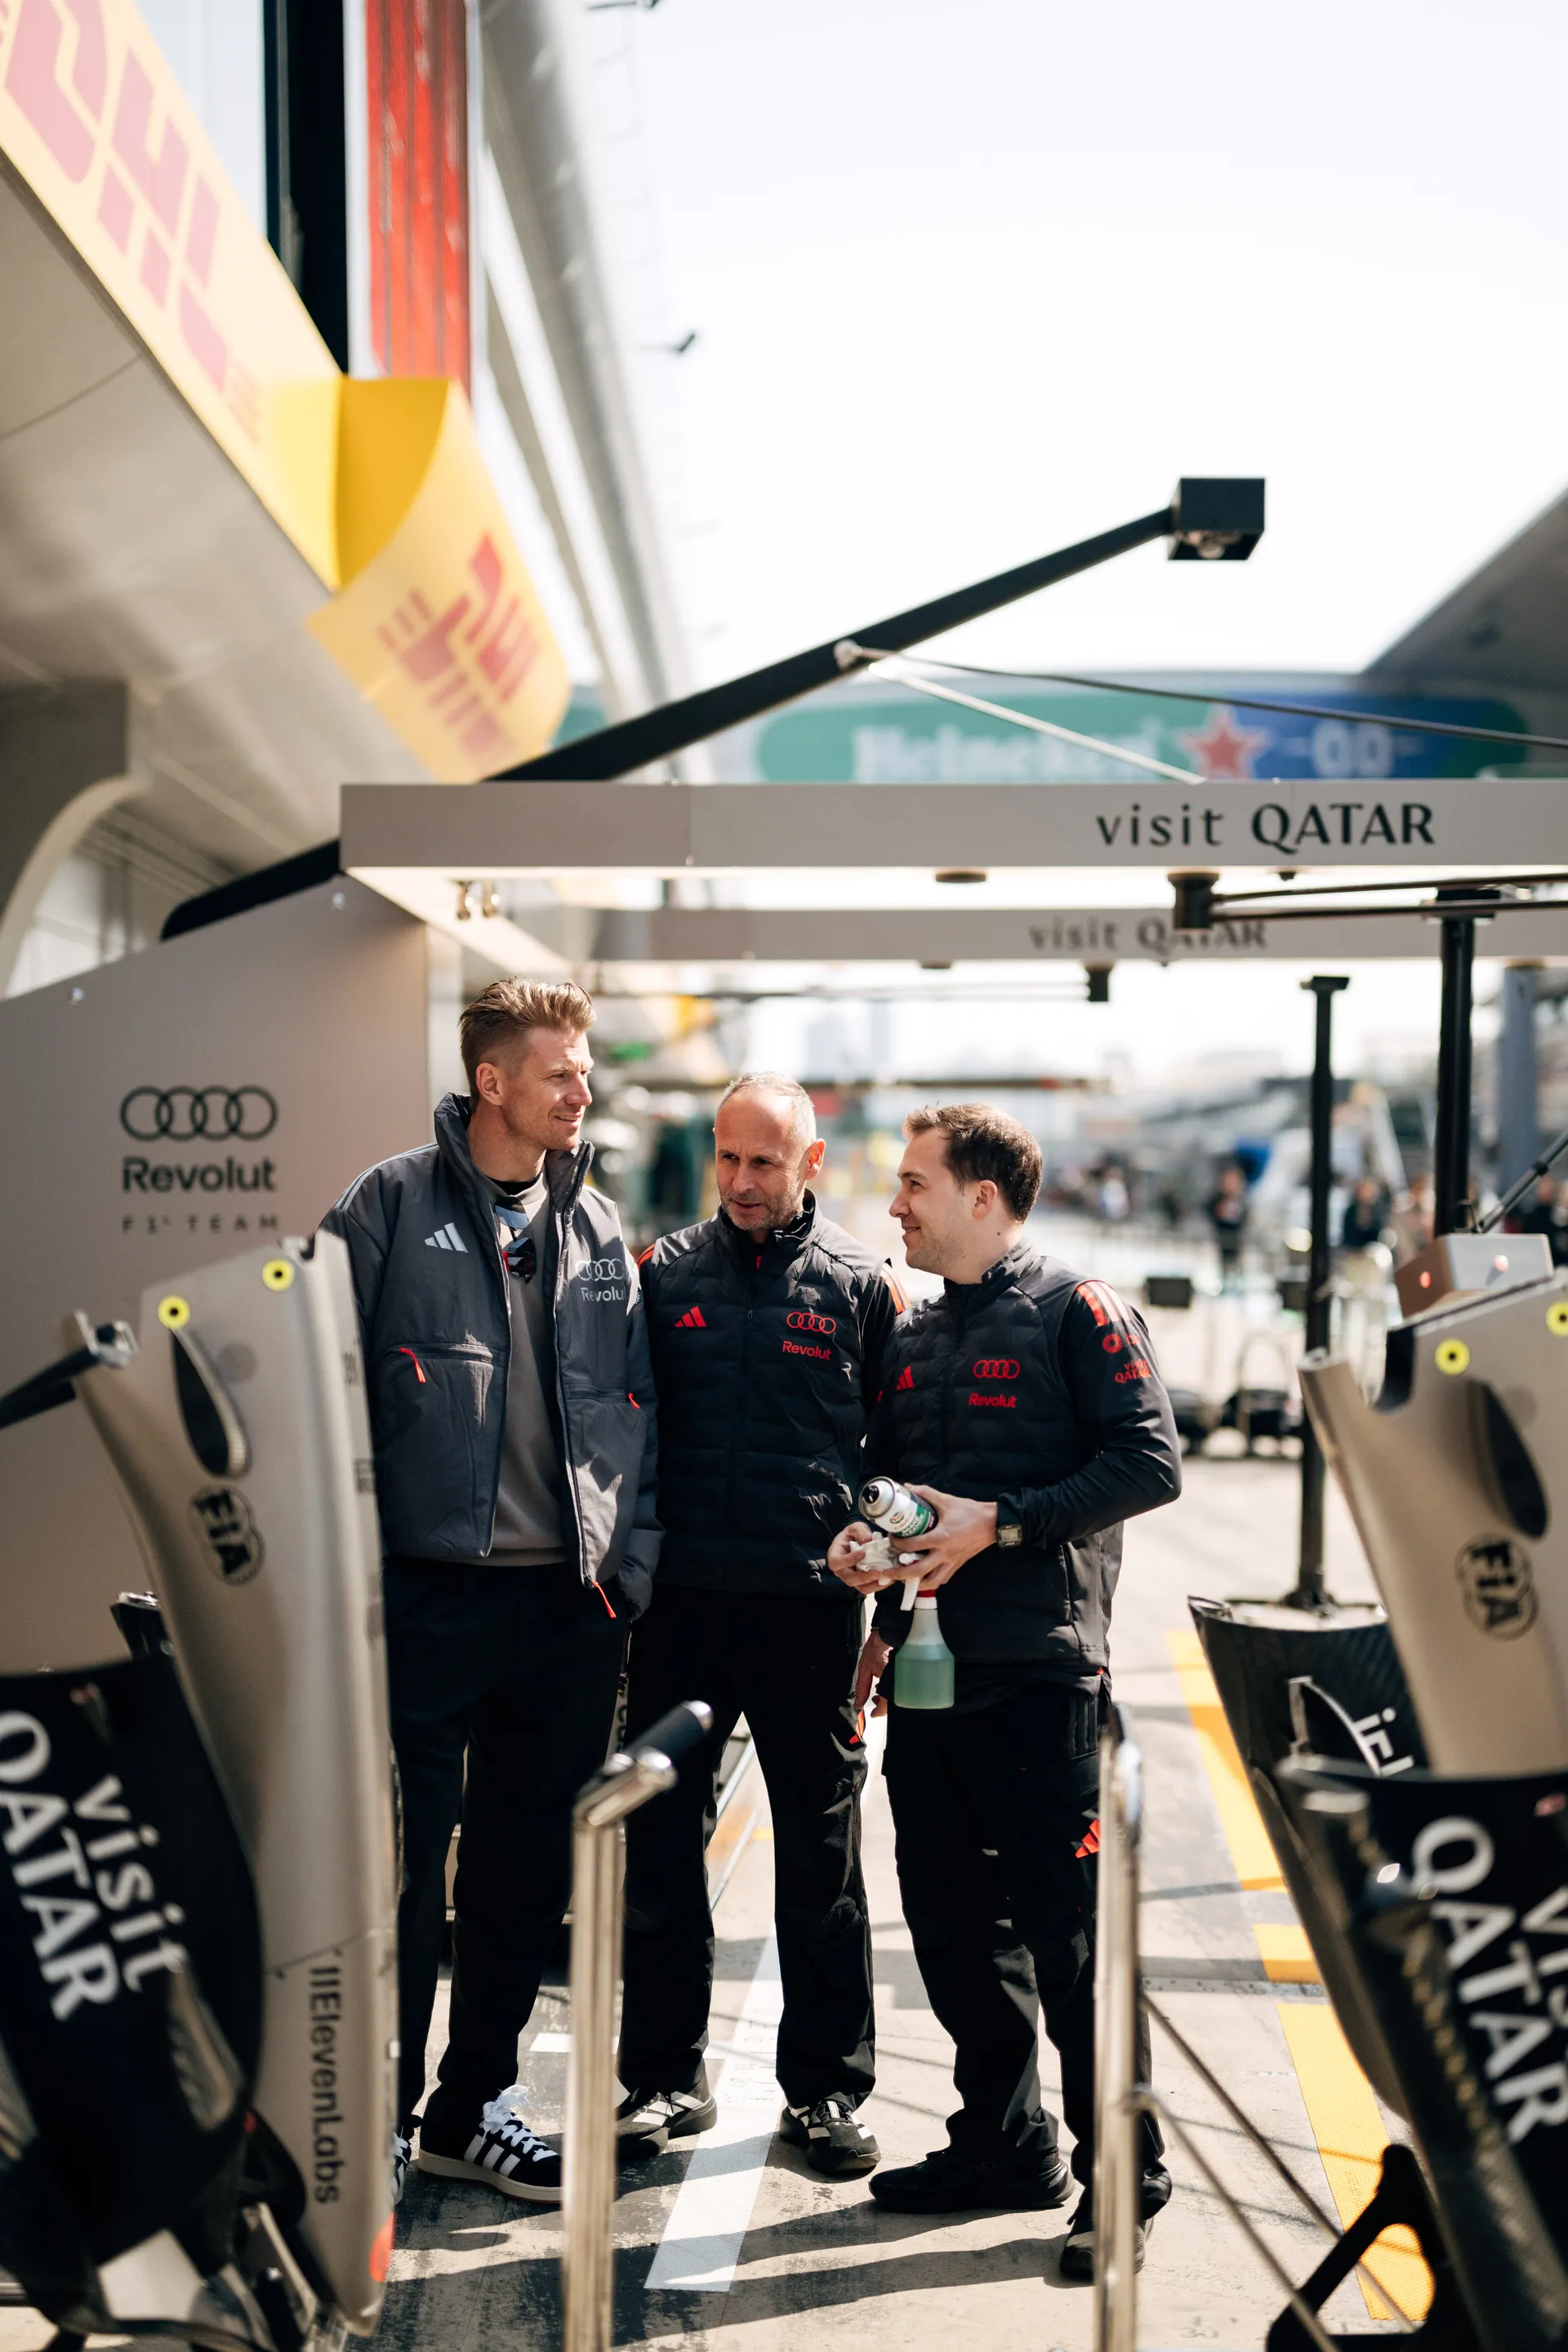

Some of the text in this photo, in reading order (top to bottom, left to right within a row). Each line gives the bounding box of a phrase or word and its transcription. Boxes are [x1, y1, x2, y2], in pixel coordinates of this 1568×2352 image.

[1096, 803, 1436, 855] visit QATAR
[1028, 915, 1119, 951] visit
[122, 1155, 276, 1192] Revolut
[188, 1214, 278, 1234] TEAM
[782, 1340, 831, 1361] Revolut
[969, 1392, 1018, 1408] Revolut
[194, 1489, 252, 1576] FIA
[1469, 1539, 1519, 1629] FIA
[74, 1775, 187, 1993] visit
[1410, 1815, 1568, 2145] QATAR
